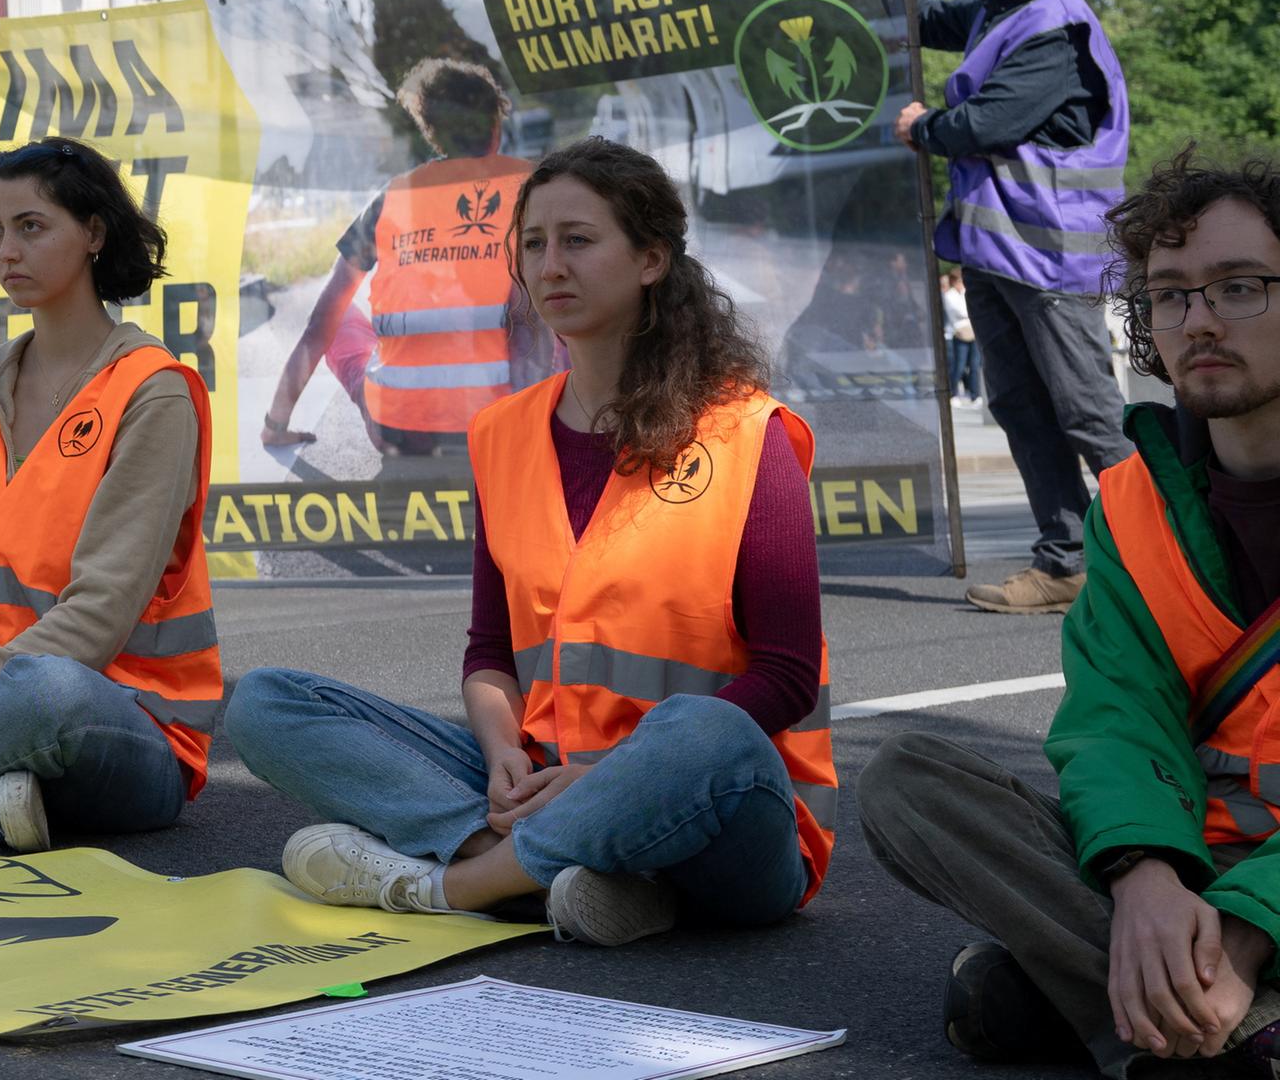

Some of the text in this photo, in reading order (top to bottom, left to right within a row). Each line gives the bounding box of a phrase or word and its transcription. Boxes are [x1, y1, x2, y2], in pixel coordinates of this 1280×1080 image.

[517, 5, 720, 74] KLIMARAT!
[392, 227, 436, 251] LETZTE
[398, 242, 502, 267] GENERATION.AT
